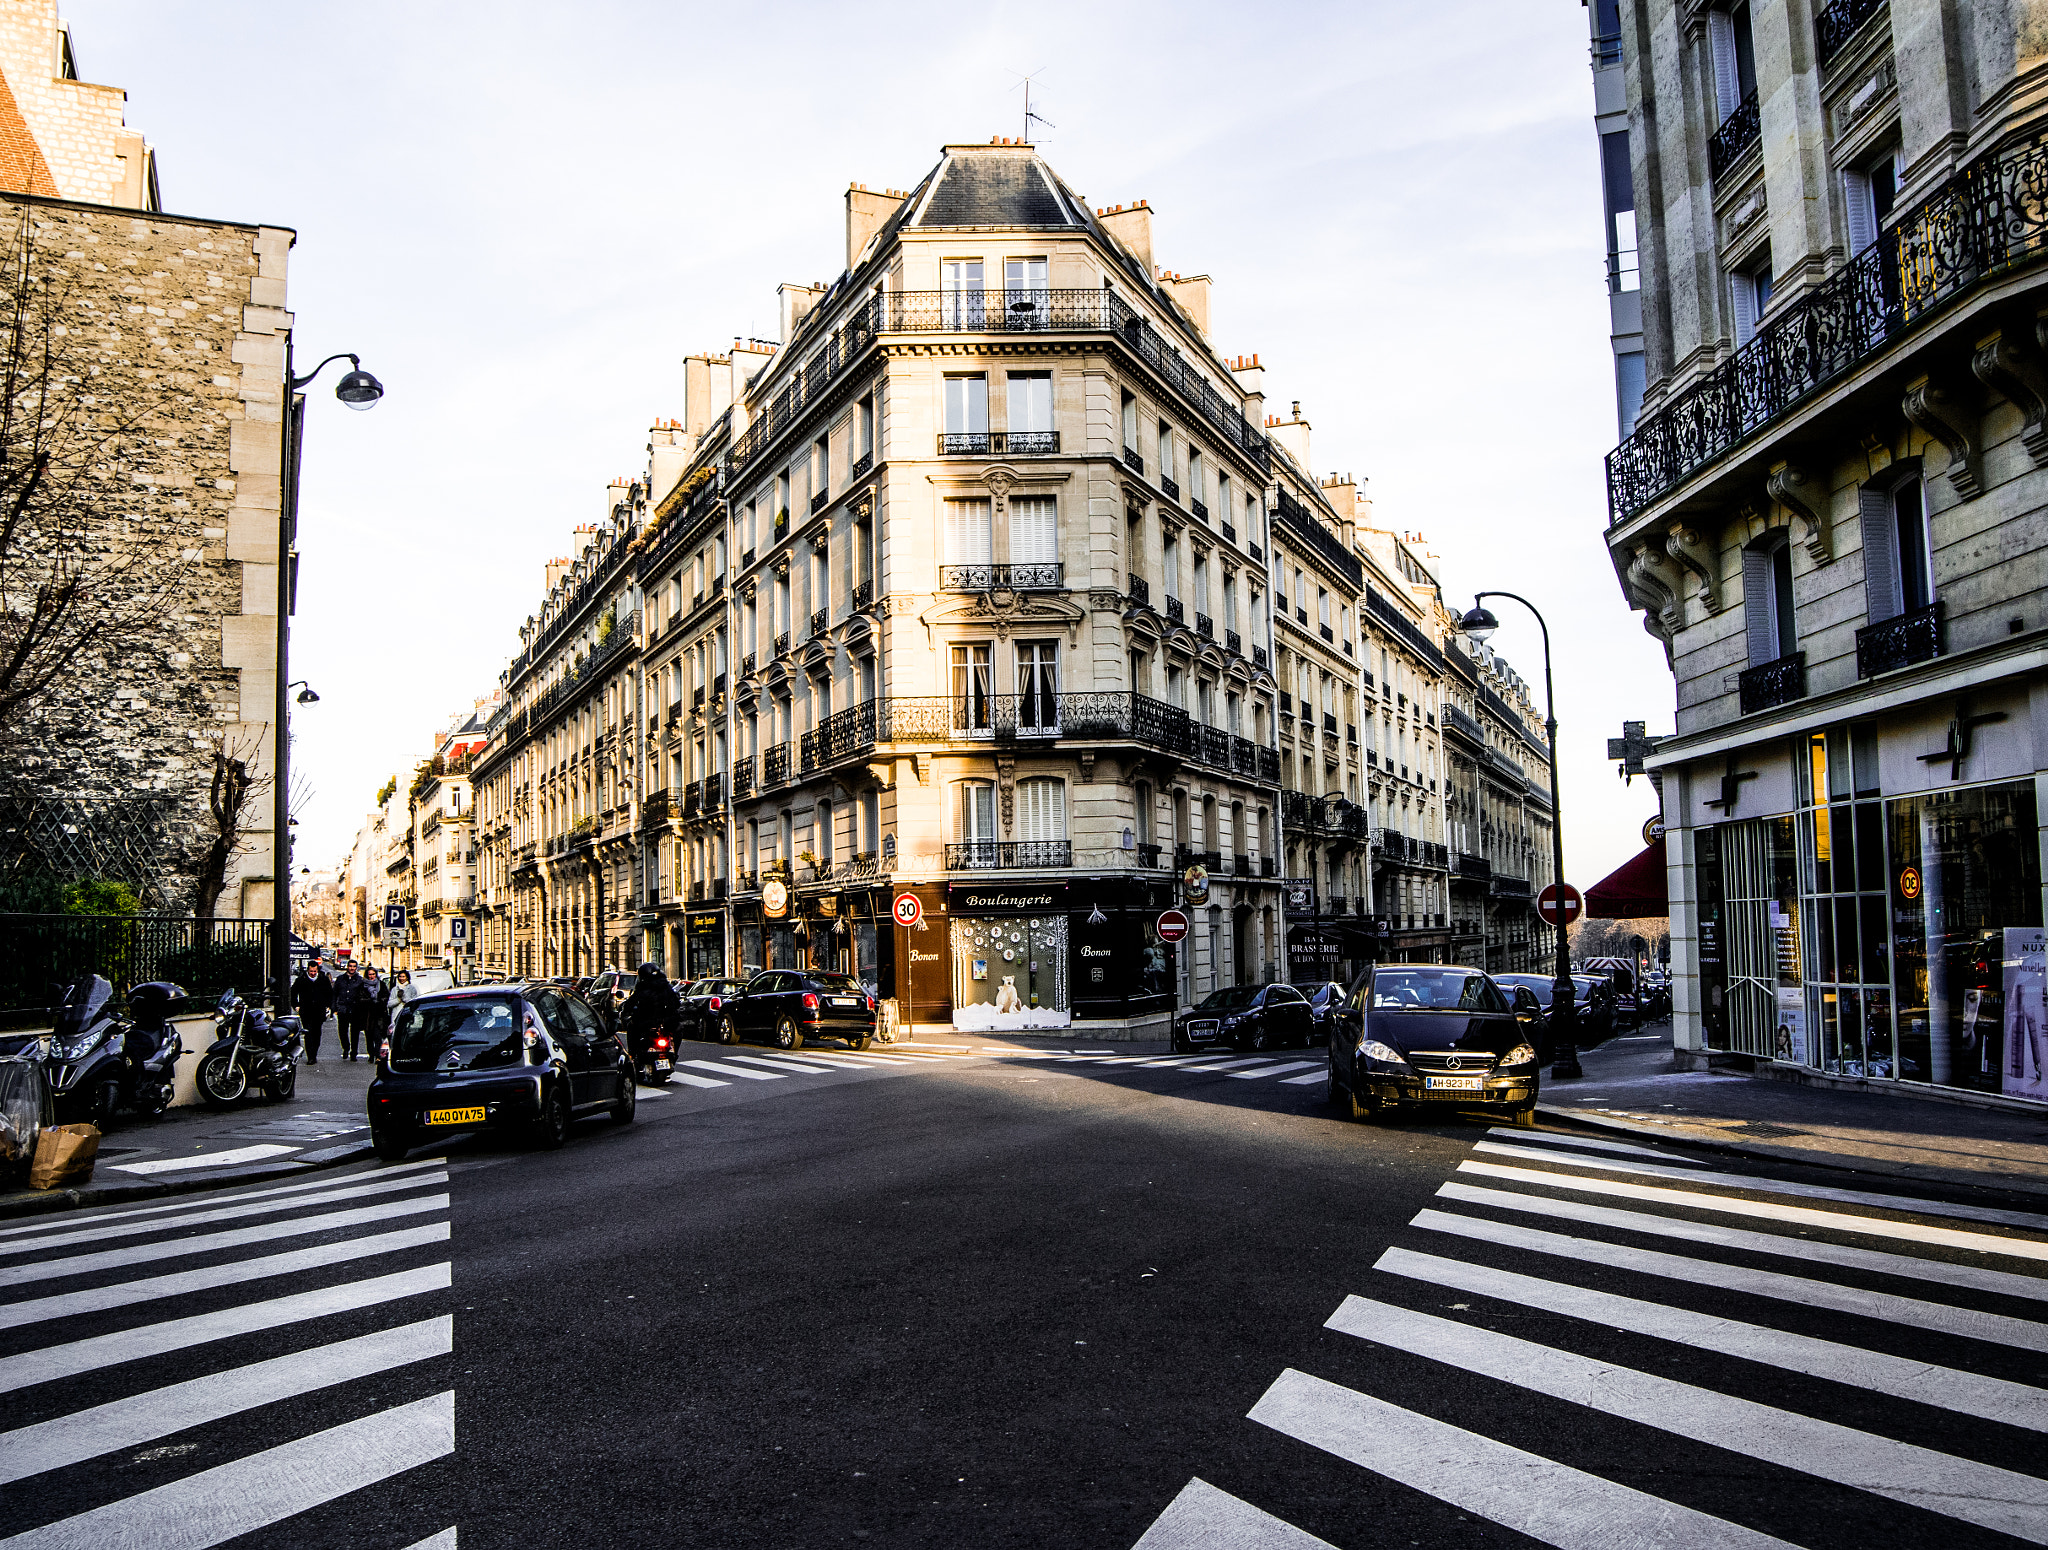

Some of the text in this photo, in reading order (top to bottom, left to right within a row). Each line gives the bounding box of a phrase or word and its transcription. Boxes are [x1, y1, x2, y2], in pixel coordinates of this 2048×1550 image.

[966, 893, 1052, 908] Boulangerie
[390, 909, 400, 924] P
[898, 903, 916, 917] 30
[455, 921, 463, 937] P
[910, 950, 939, 961] Bonon
[1081, 946, 1111, 957] Bonon
[1291, 944, 1339, 953] BRASSERIE
[433, 1112, 451, 1122] 440
[470, 1108, 484, 1120] 75
